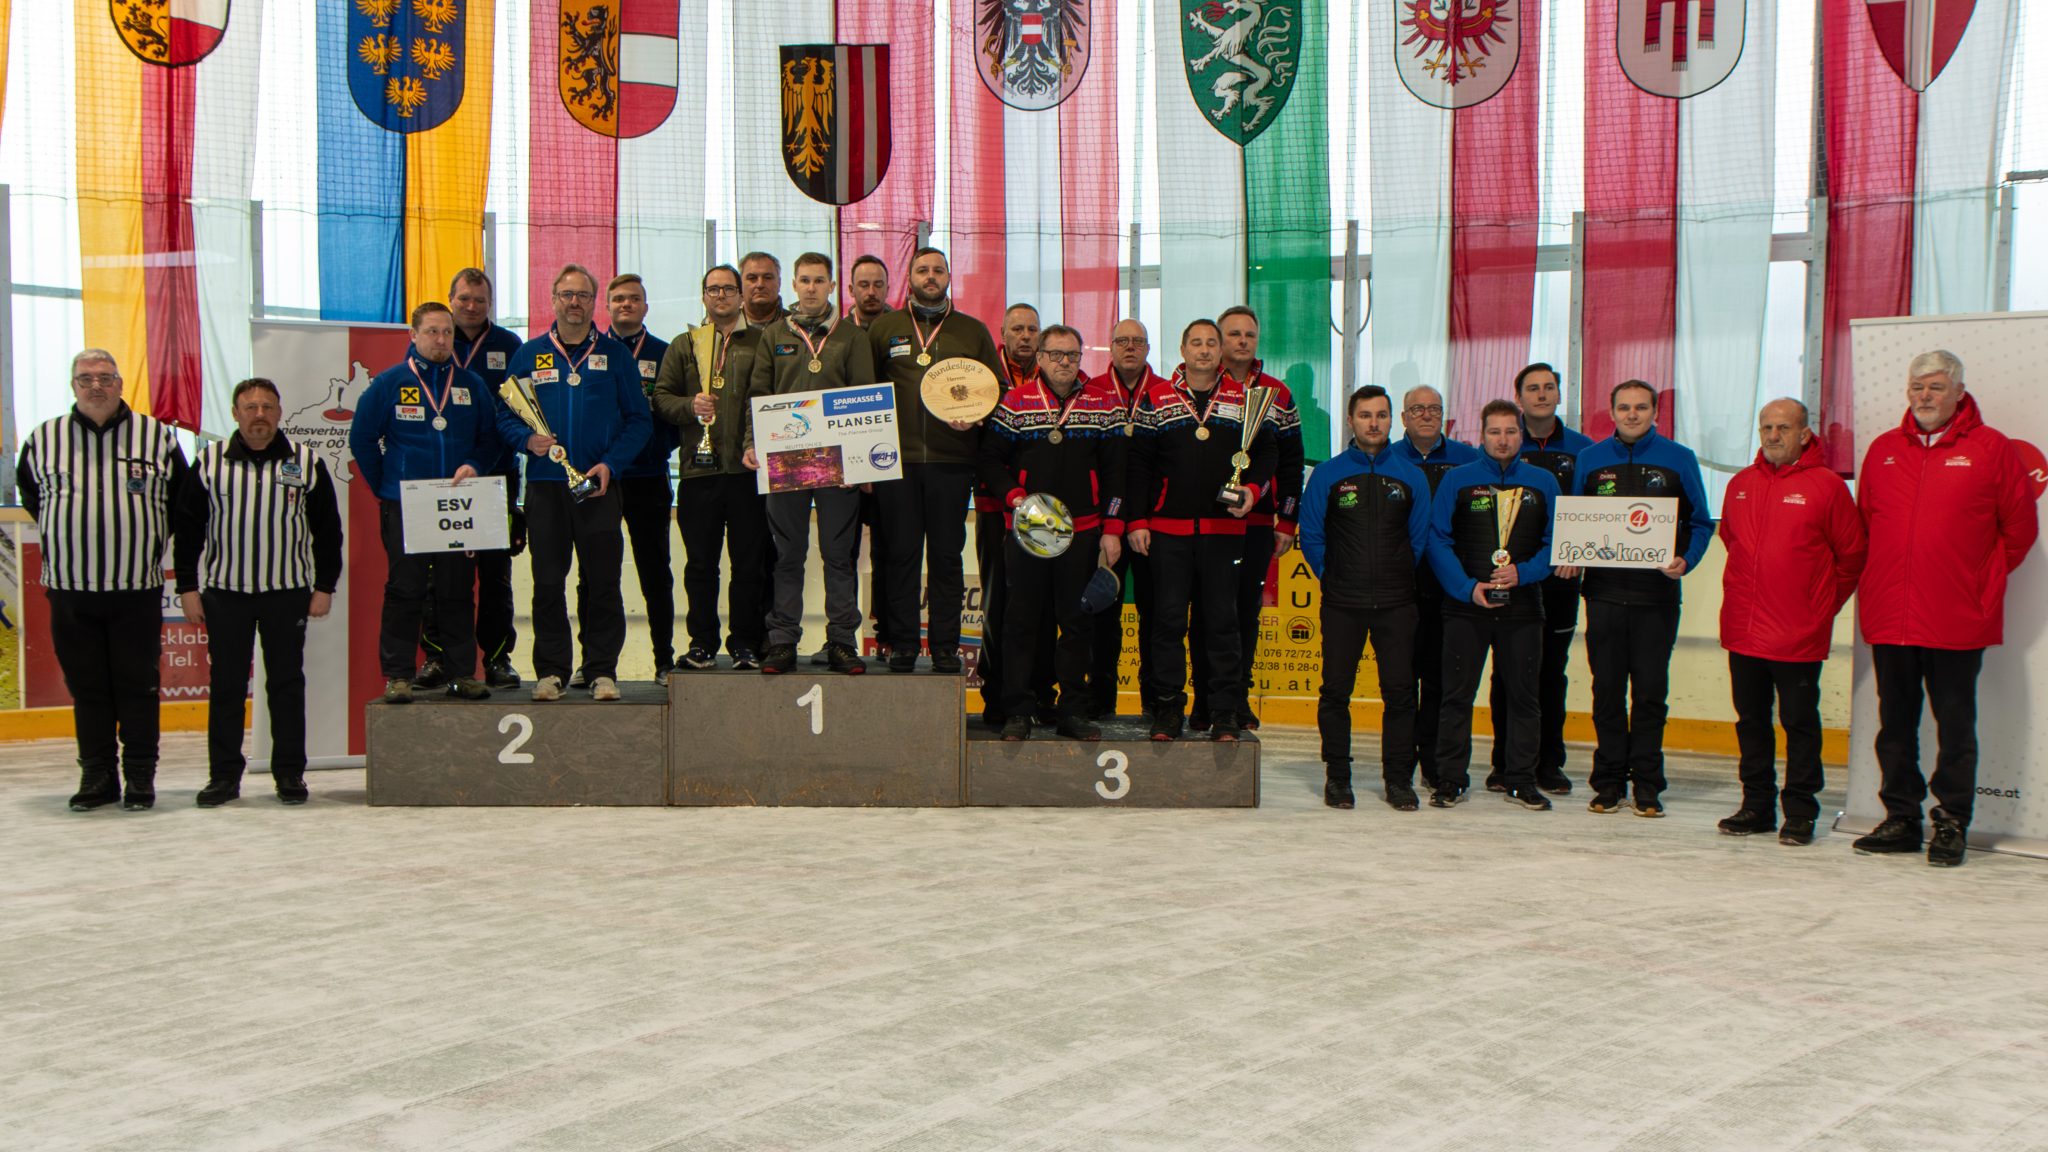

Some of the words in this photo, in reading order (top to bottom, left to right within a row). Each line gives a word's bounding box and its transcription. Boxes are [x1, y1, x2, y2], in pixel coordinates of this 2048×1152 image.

[928, 359, 976, 380] Bundesliga
[833, 395, 875, 407] SPARKASSE
[827, 413, 893, 429] PLANSEE
[437, 498, 473, 512] ESV
[438, 517, 474, 531] Oed
[1556, 512, 1629, 523] STOCKSPORT
[1631, 511, 1646, 527] 4
[1651, 514, 1675, 524] YOU
[165, 649, 199, 667] Tel.
[1263, 648, 1282, 658] 076
[1285, 649, 1312, 659] 72/72
[1283, 662, 1295, 671] 16
[1297, 662, 1319, 672] 28-0
[796, 683, 823, 735] 1
[498, 713, 535, 764] 2
[1095, 749, 1131, 800] 3
